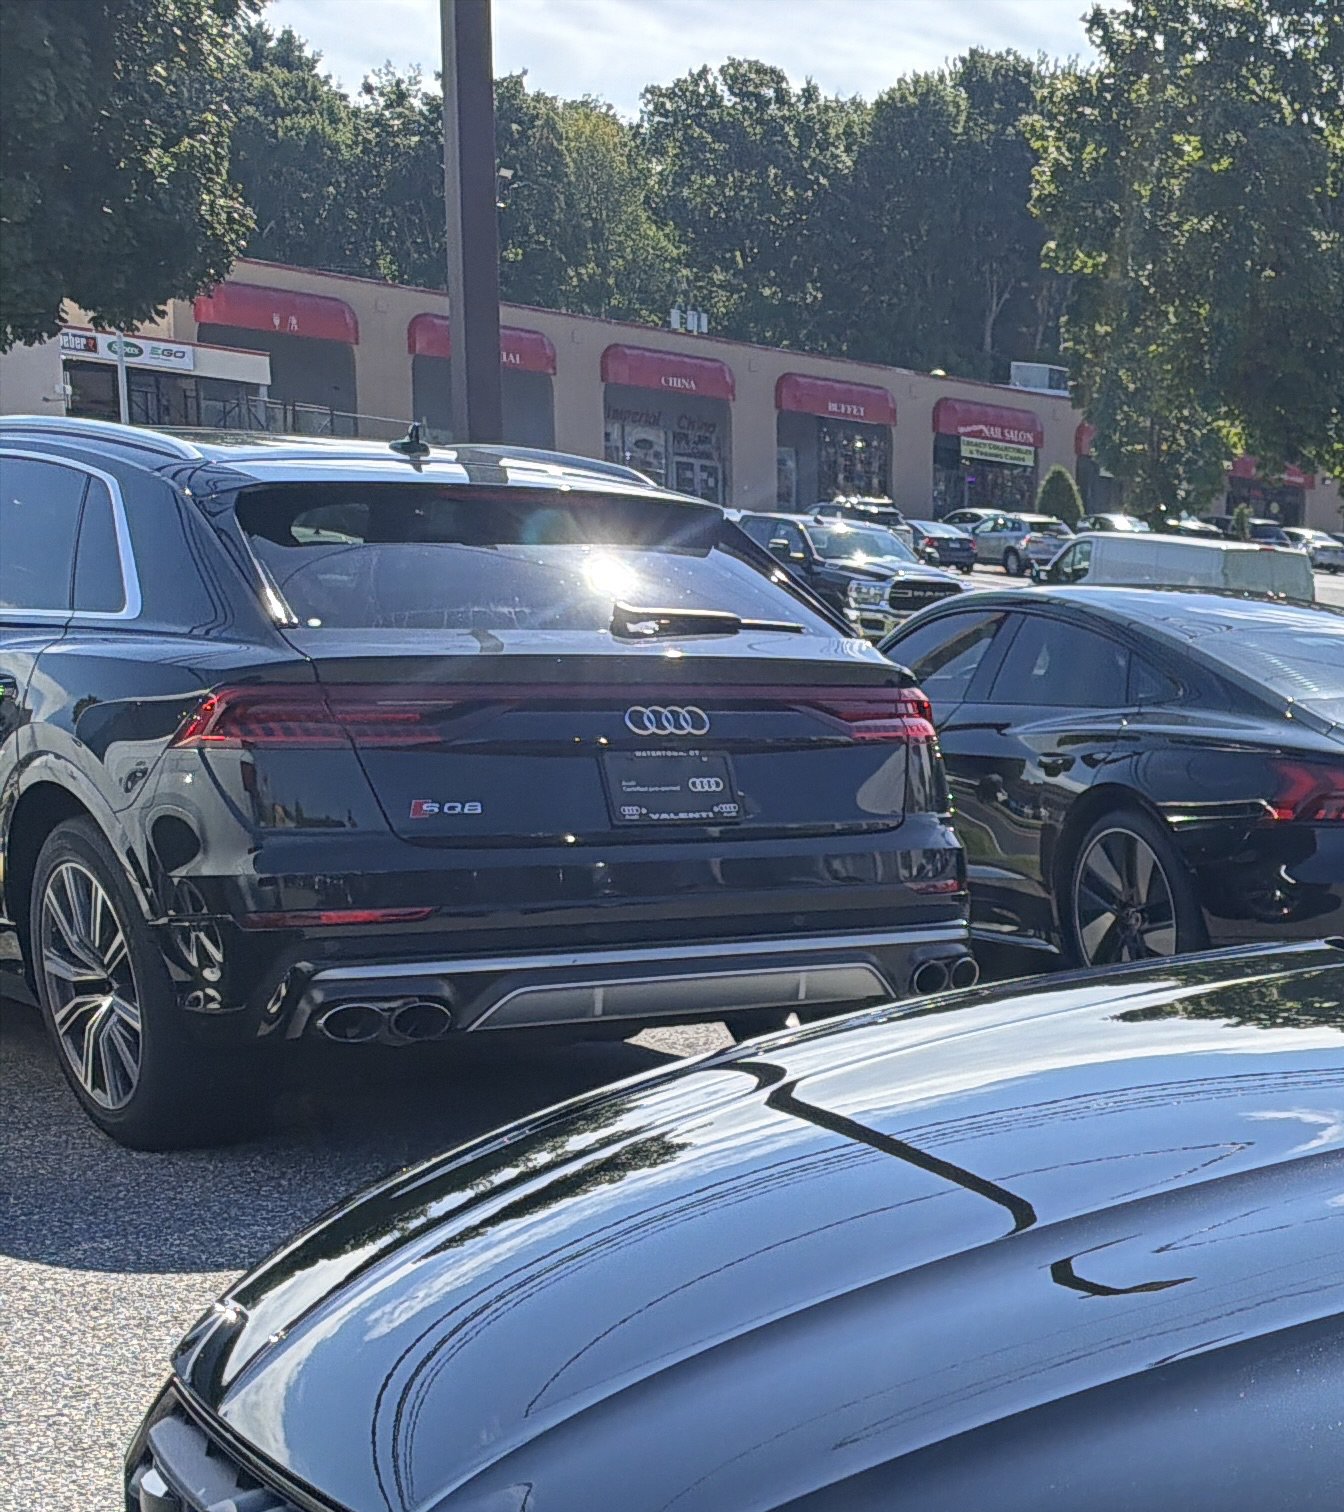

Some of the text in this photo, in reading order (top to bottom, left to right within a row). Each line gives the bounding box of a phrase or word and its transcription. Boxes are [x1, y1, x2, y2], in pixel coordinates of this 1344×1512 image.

[150, 346, 186, 359] EGO
[661, 376, 696, 390] CHINA
[828, 401, 865, 416] BUFFET
[982, 425, 1002, 439] NAIL
[1004, 428, 1034, 444] SALON
[422, 802, 482, 814] SQ8
[649, 811, 715, 820] VALENTI
